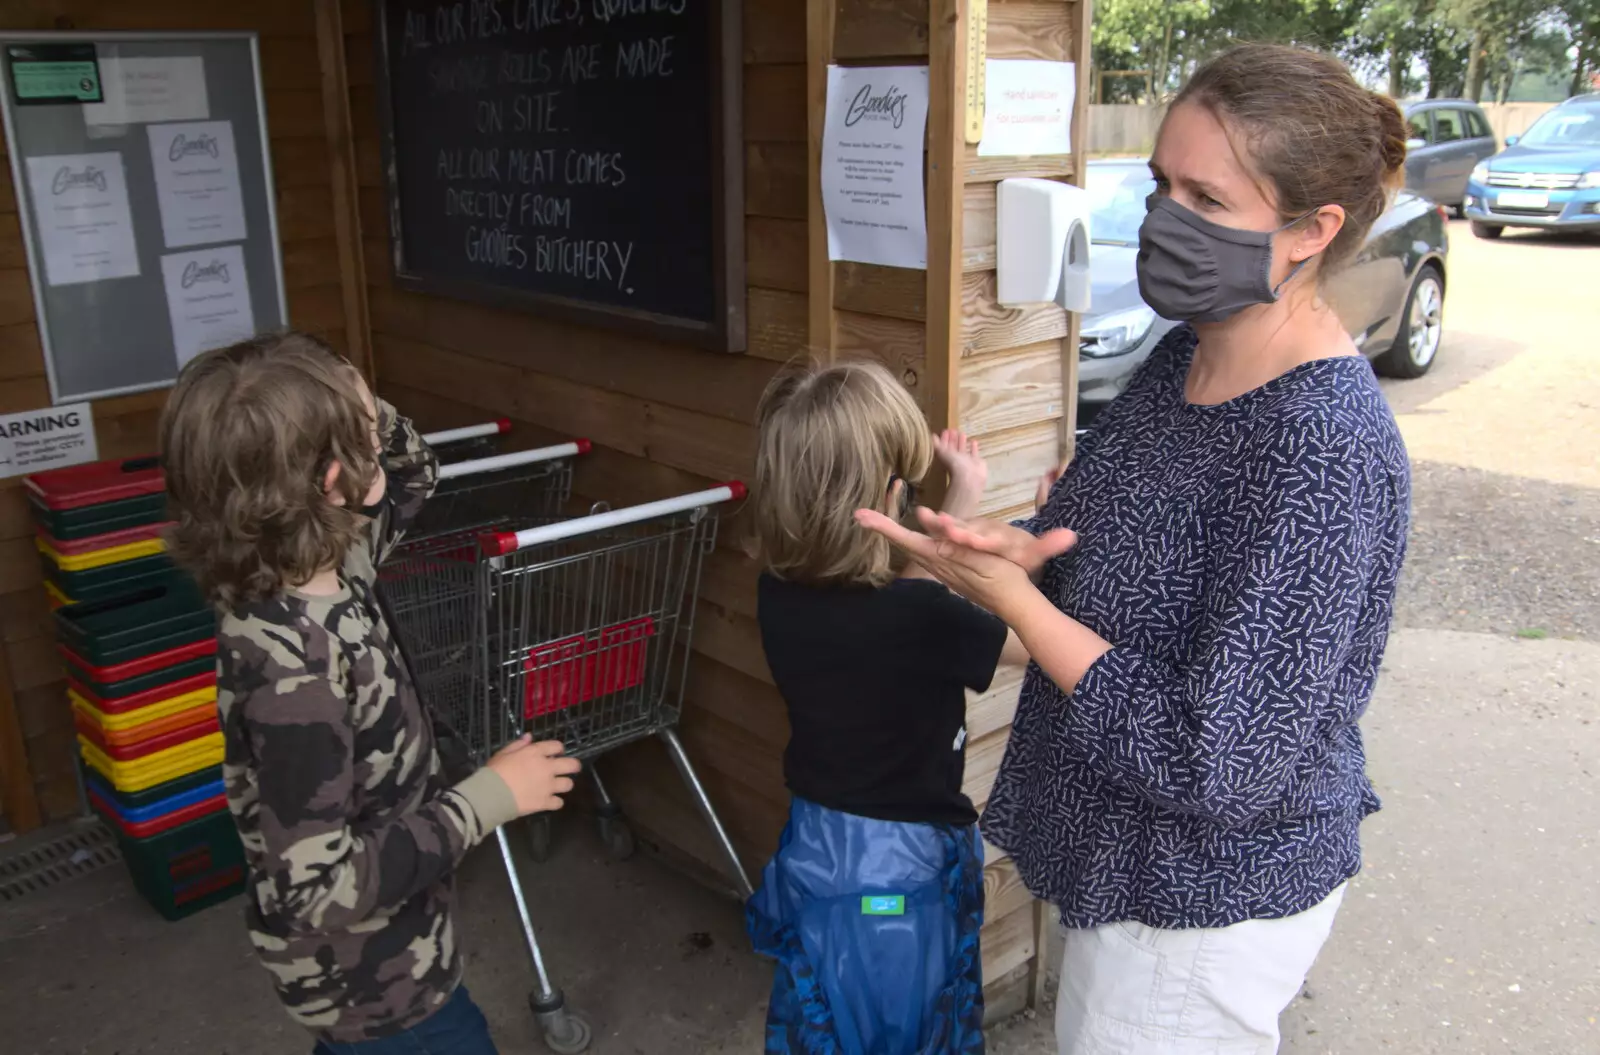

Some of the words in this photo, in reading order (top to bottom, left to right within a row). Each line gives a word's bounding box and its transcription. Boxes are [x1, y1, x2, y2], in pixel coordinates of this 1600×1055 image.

[435, 3, 466, 44] OUR
[560, 43, 602, 84] ARE
[615, 35, 675, 79] MADE
[476, 99, 504, 133] ON
[436, 148, 464, 180] ALL
[468, 148, 501, 183] OUR
[508, 148, 556, 185] MEAT
[565, 148, 626, 187] COMES
[444, 187, 515, 221] DIRECTLY
[519, 192, 571, 229] FROM
[59, 439, 85, 450] CCTV
